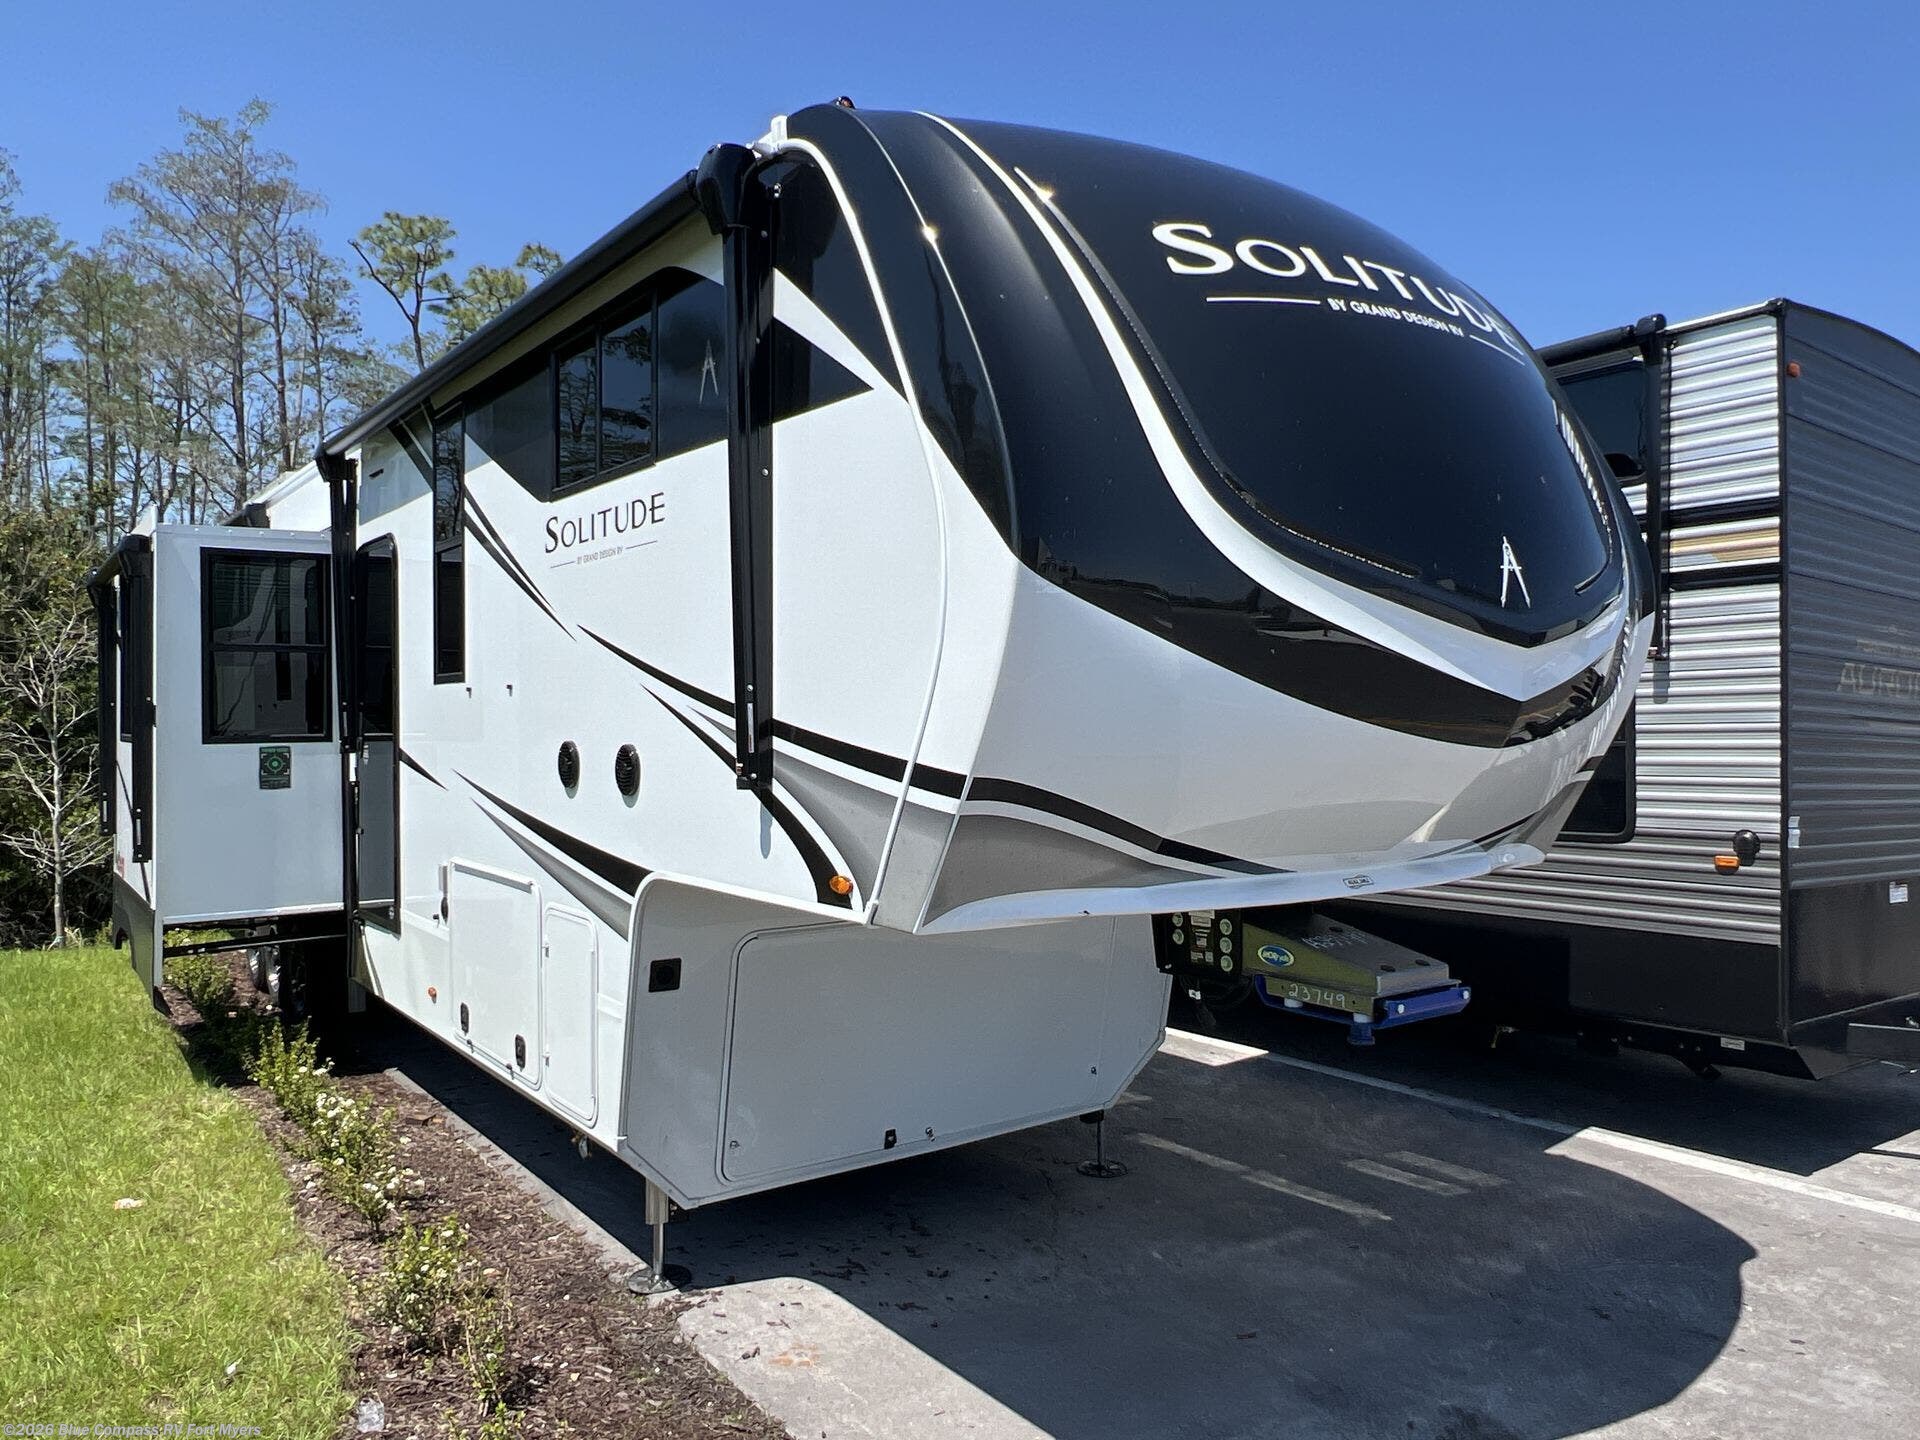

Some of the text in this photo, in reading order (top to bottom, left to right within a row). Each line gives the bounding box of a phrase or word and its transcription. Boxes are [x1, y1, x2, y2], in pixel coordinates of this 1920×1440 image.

[1152, 222, 1525, 356] SOLITUDE
[1327, 297, 1347, 311] BY
[1350, 300, 1401, 320] GRAND
[1401, 310, 1450, 333] DESIGN
[545, 491, 666, 554] SOLITUDE
[1288, 983, 1345, 1009] 23749
